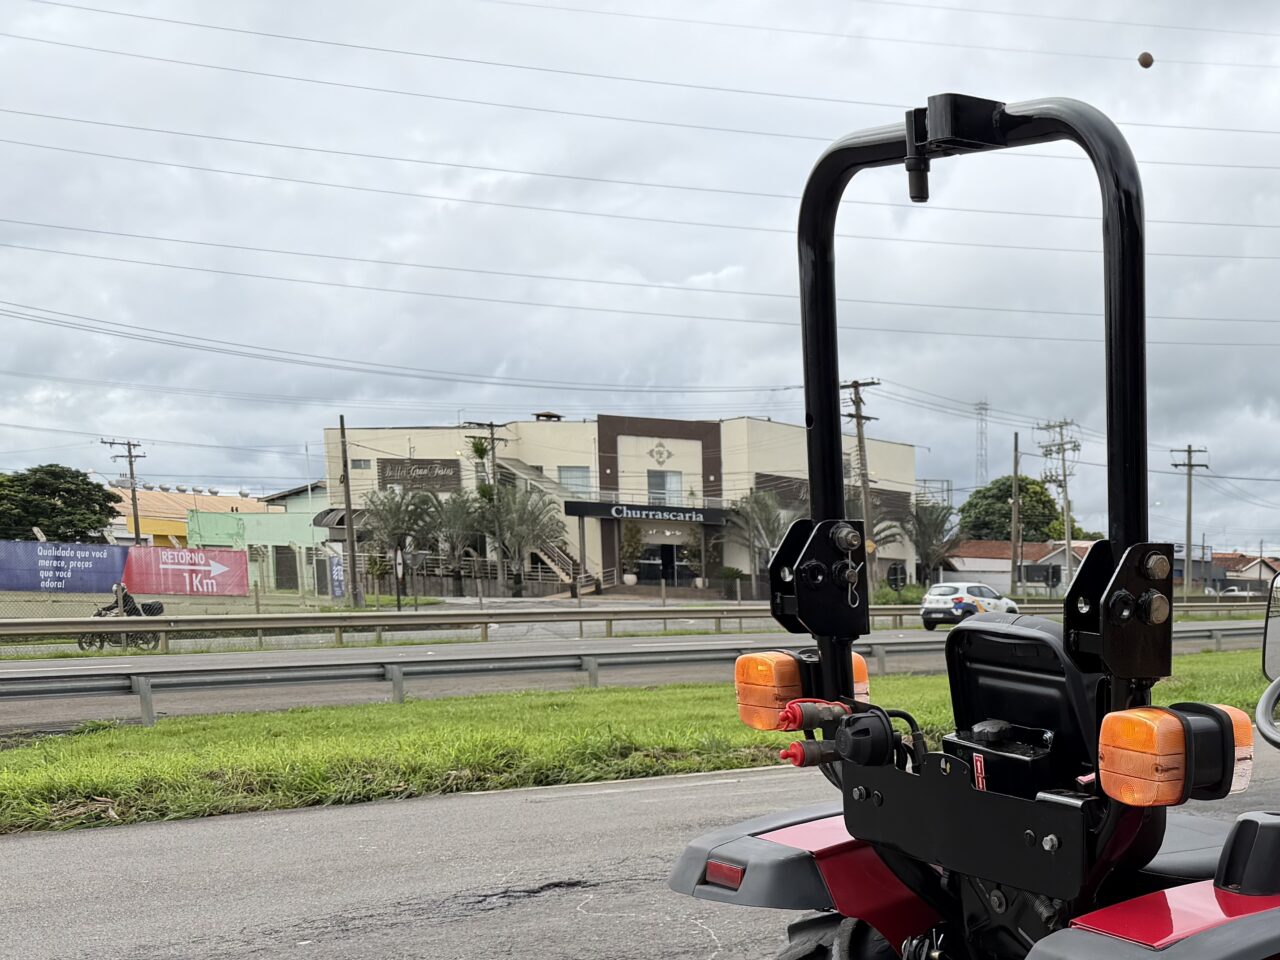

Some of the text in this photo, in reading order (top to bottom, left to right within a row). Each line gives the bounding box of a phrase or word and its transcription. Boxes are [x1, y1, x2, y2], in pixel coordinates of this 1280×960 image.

[611, 505, 704, 521] Churrascaria
[37, 546, 108, 558] Qualidade que você
[161, 551, 206, 563] RETORNO
[38, 559, 67, 568] merece,
[39, 569, 72, 578] que você
[40, 578, 65, 588] adora!
